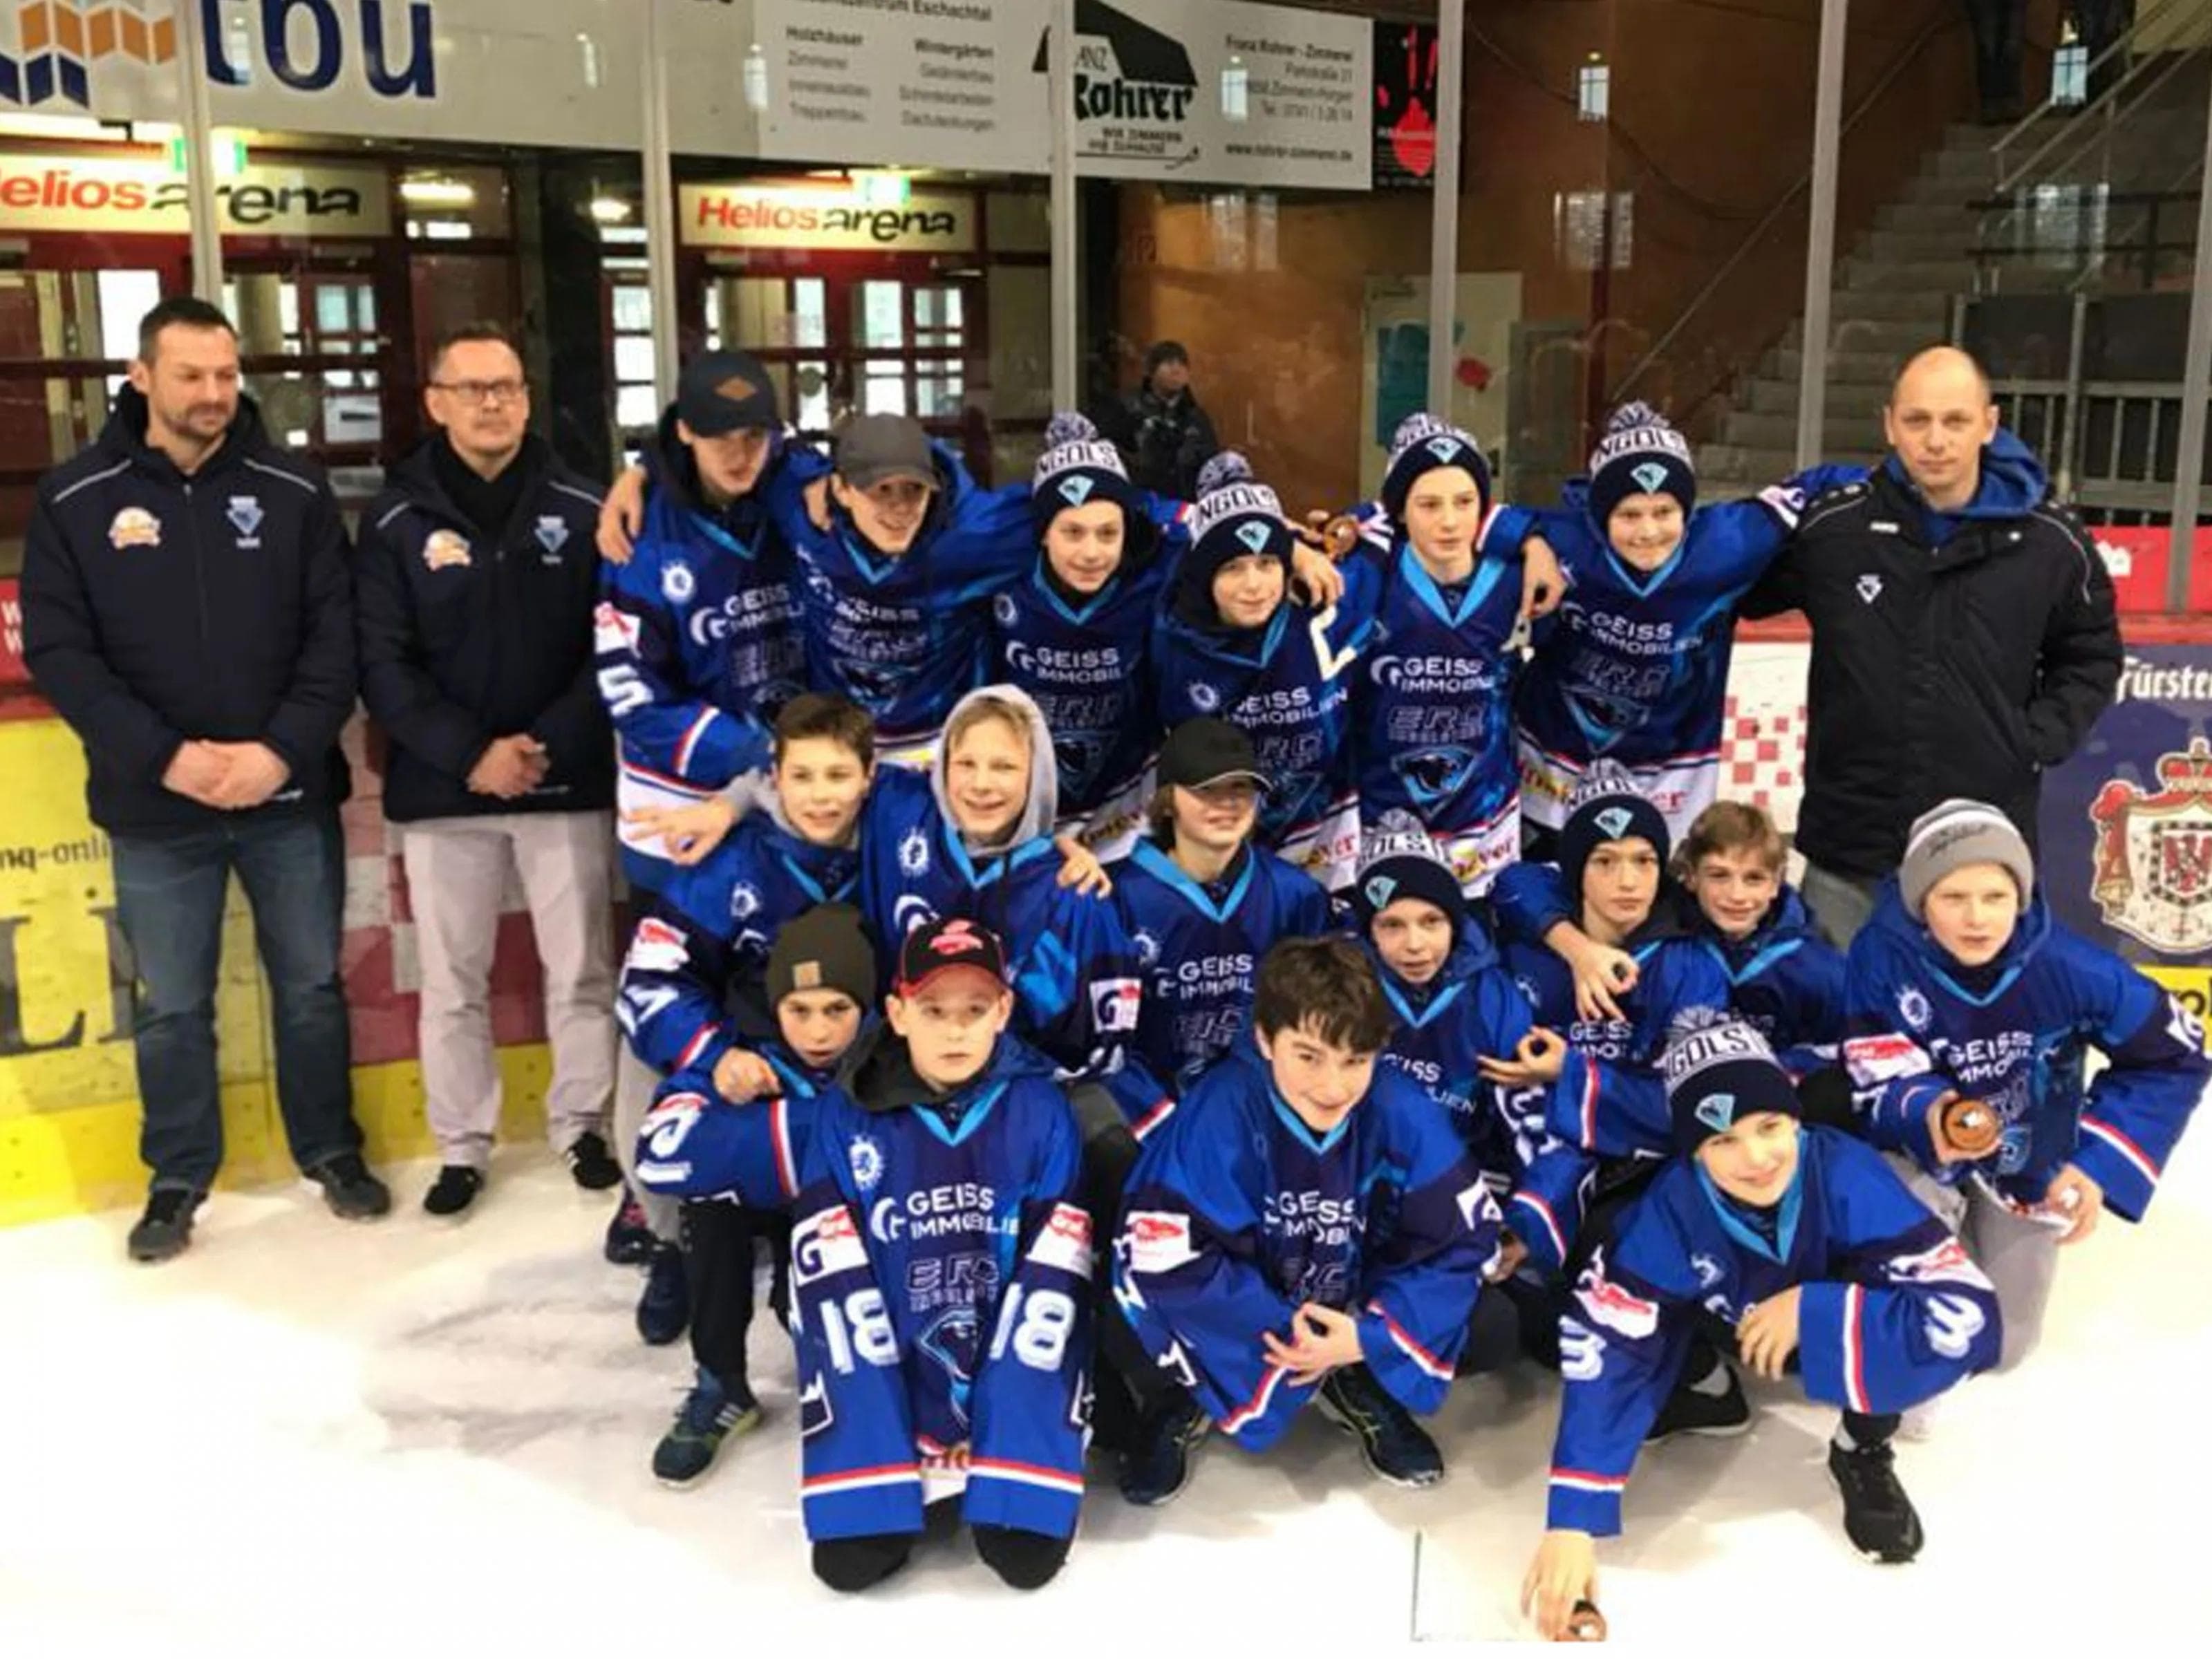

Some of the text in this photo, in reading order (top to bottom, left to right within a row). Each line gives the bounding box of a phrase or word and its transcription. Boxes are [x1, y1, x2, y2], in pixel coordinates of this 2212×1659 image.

[2115, 656, 2212, 704] Fürste
[906, 1182, 995, 1216] GEISS
[821, 1287, 900, 1375] 18
[990, 1282, 1076, 1372] 18
